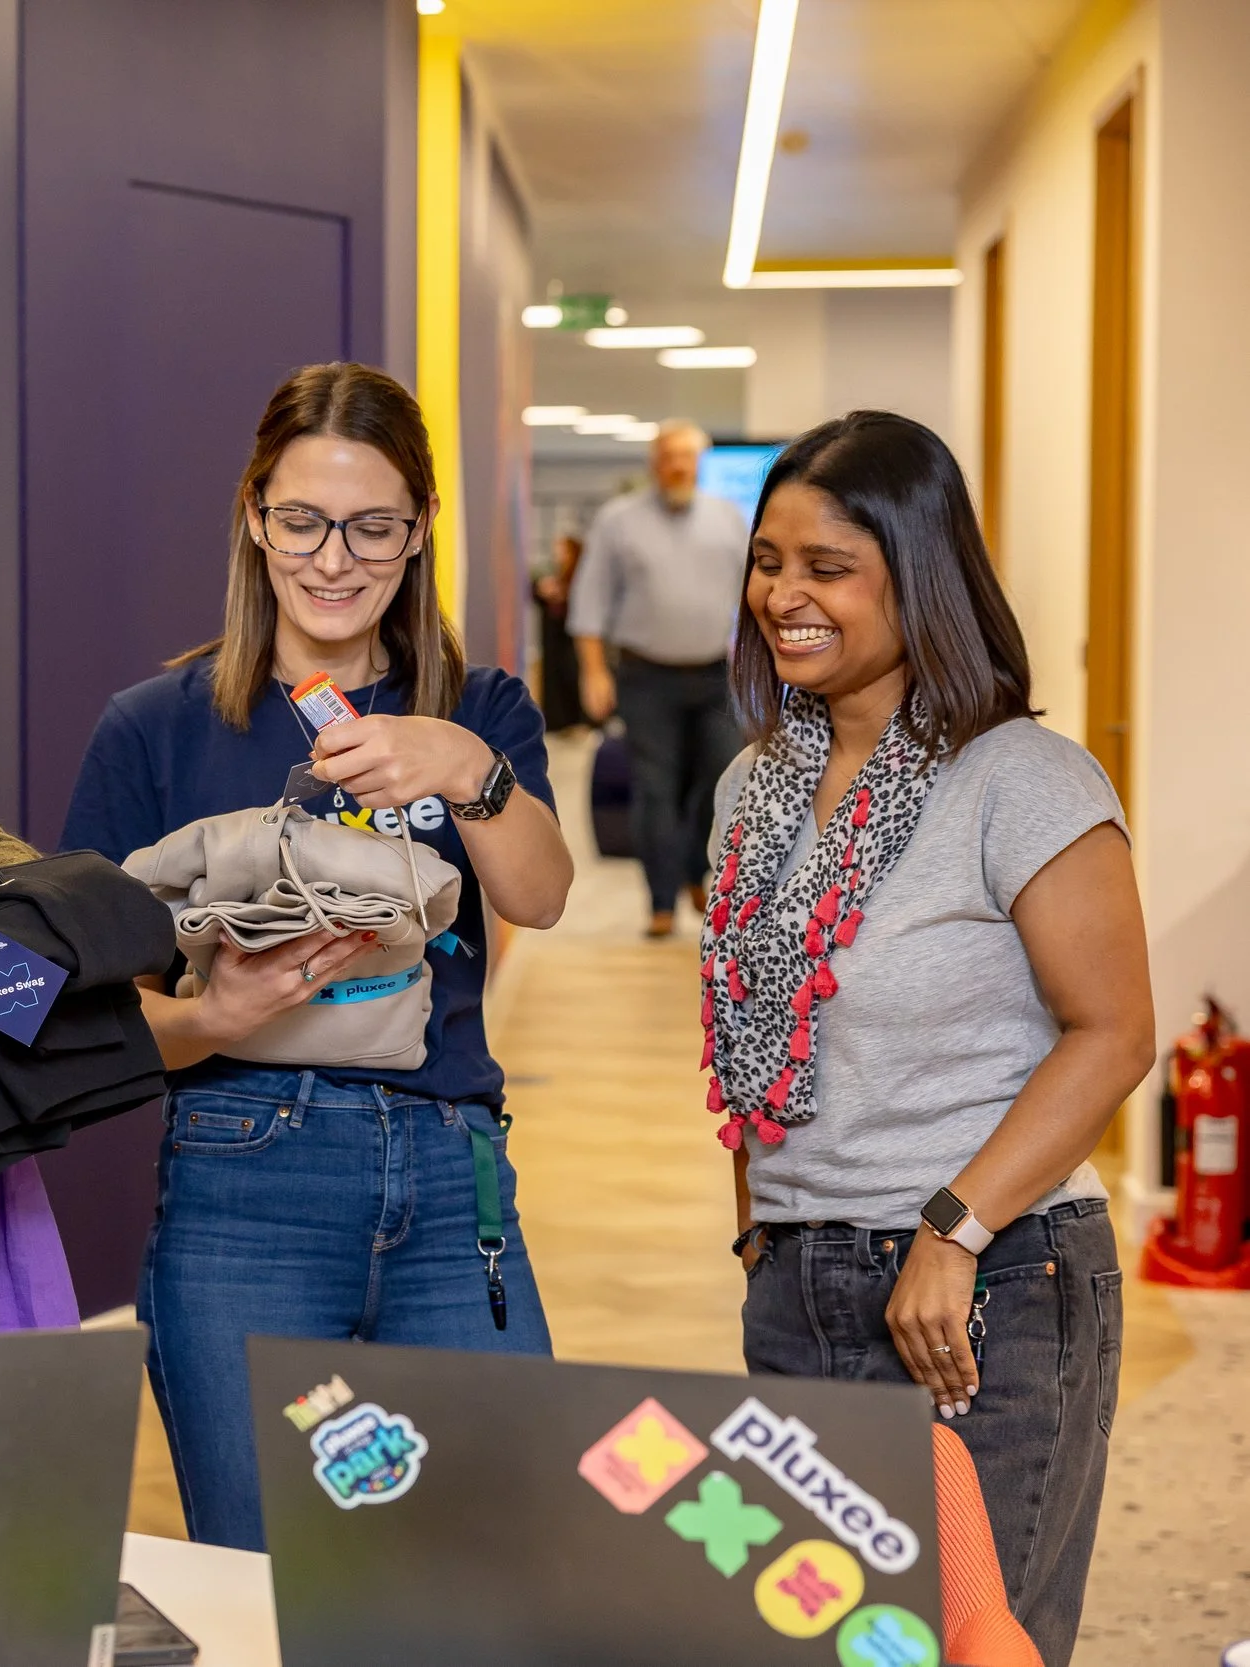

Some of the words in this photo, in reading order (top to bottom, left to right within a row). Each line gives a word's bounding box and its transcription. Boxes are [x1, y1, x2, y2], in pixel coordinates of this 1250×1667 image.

[15, 977, 45, 990] Swag
[346, 981, 396, 998] pluxee
[322, 1423, 418, 1499] park
[727, 1415, 904, 1561] pluxee
